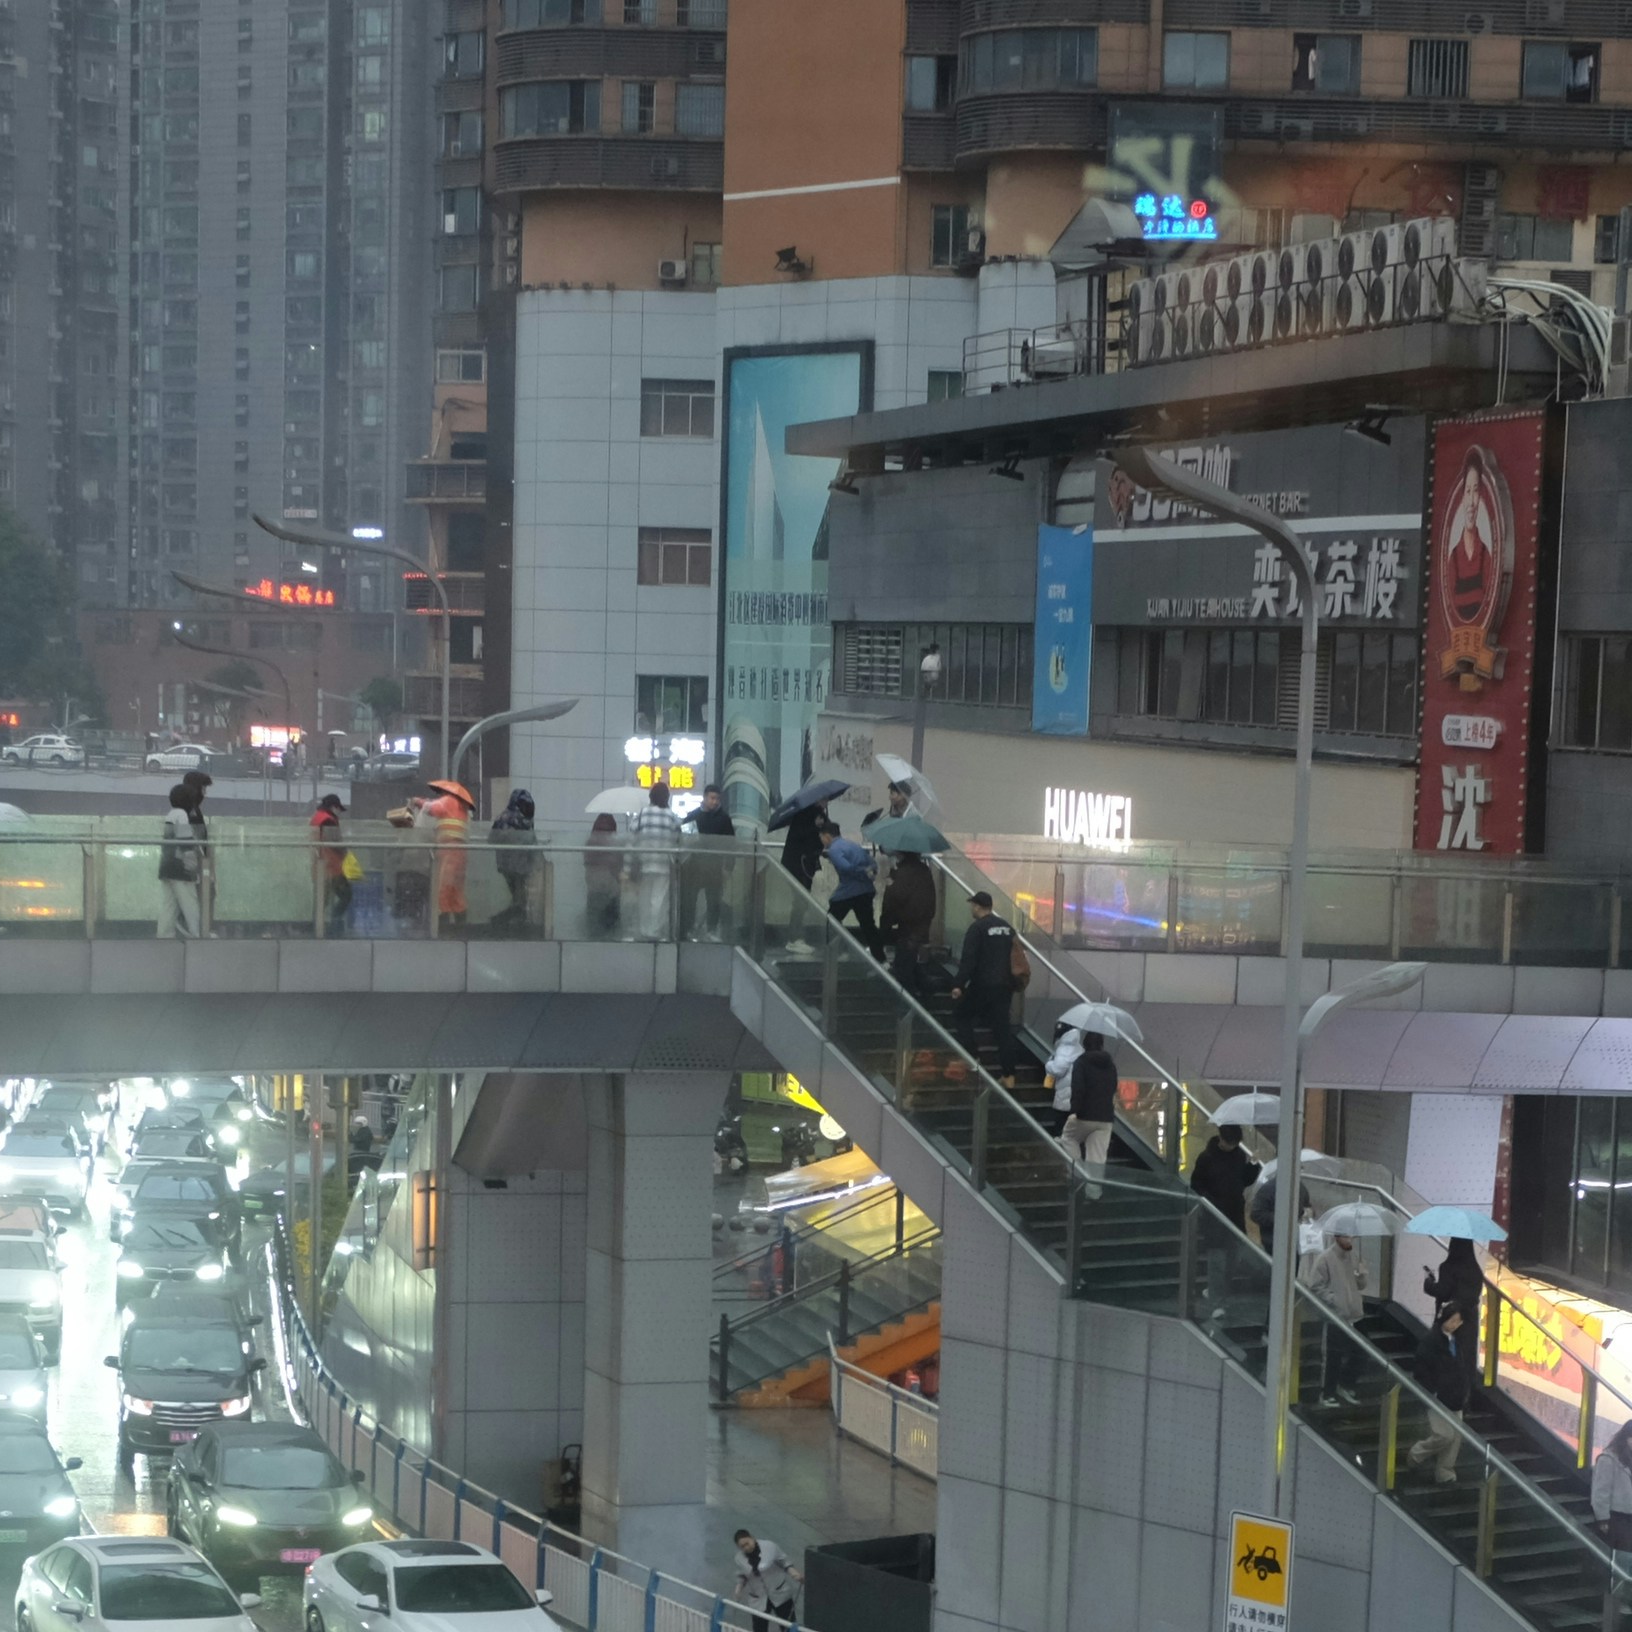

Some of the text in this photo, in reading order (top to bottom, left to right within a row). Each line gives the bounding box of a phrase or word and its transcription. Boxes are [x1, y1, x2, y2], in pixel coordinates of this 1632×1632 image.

[1044, 786, 1132, 844] HUAWEI
[1437, 764, 1488, 850] 沈
[1228, 1603, 1286, 1629] 行人请勿横穿
